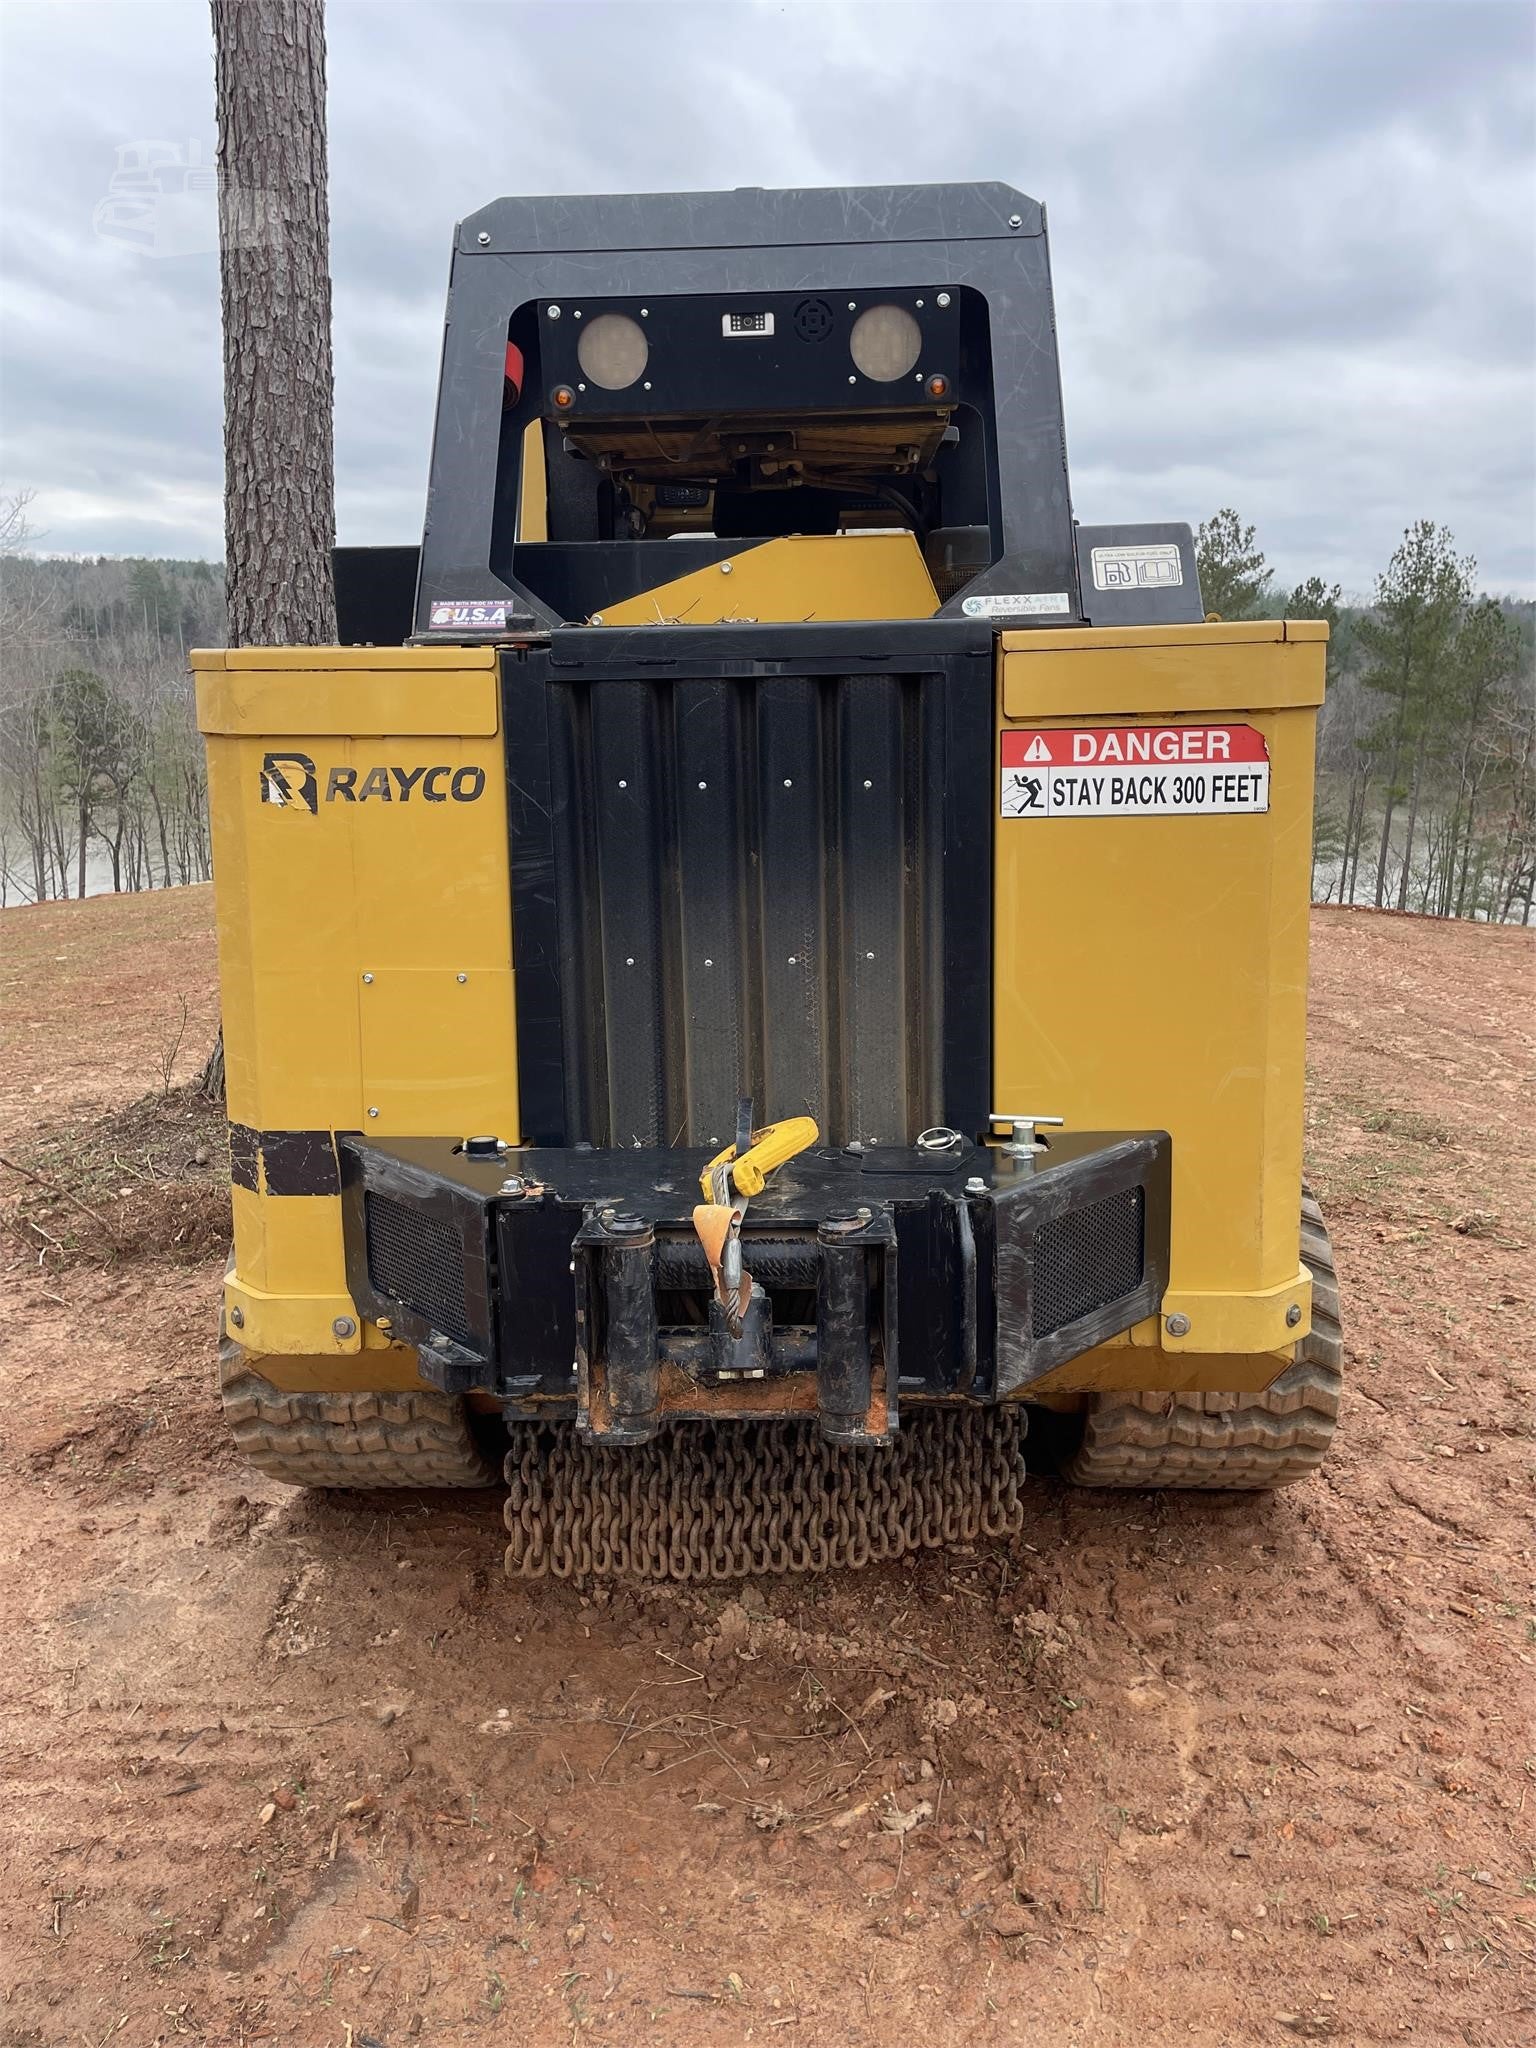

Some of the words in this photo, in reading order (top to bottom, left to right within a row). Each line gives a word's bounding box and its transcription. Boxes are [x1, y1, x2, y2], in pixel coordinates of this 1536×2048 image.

[991, 604, 1037, 613] Reversible
[1040, 603, 1061, 611] Fans
[1072, 730, 1231, 762] DANGER
[325, 766, 486, 803] RAYCO
[1052, 778, 1105, 807] STAY
[1111, 776, 1168, 805] BACK
[1173, 775, 1206, 804] 300
[1212, 774, 1263, 803] FEET
